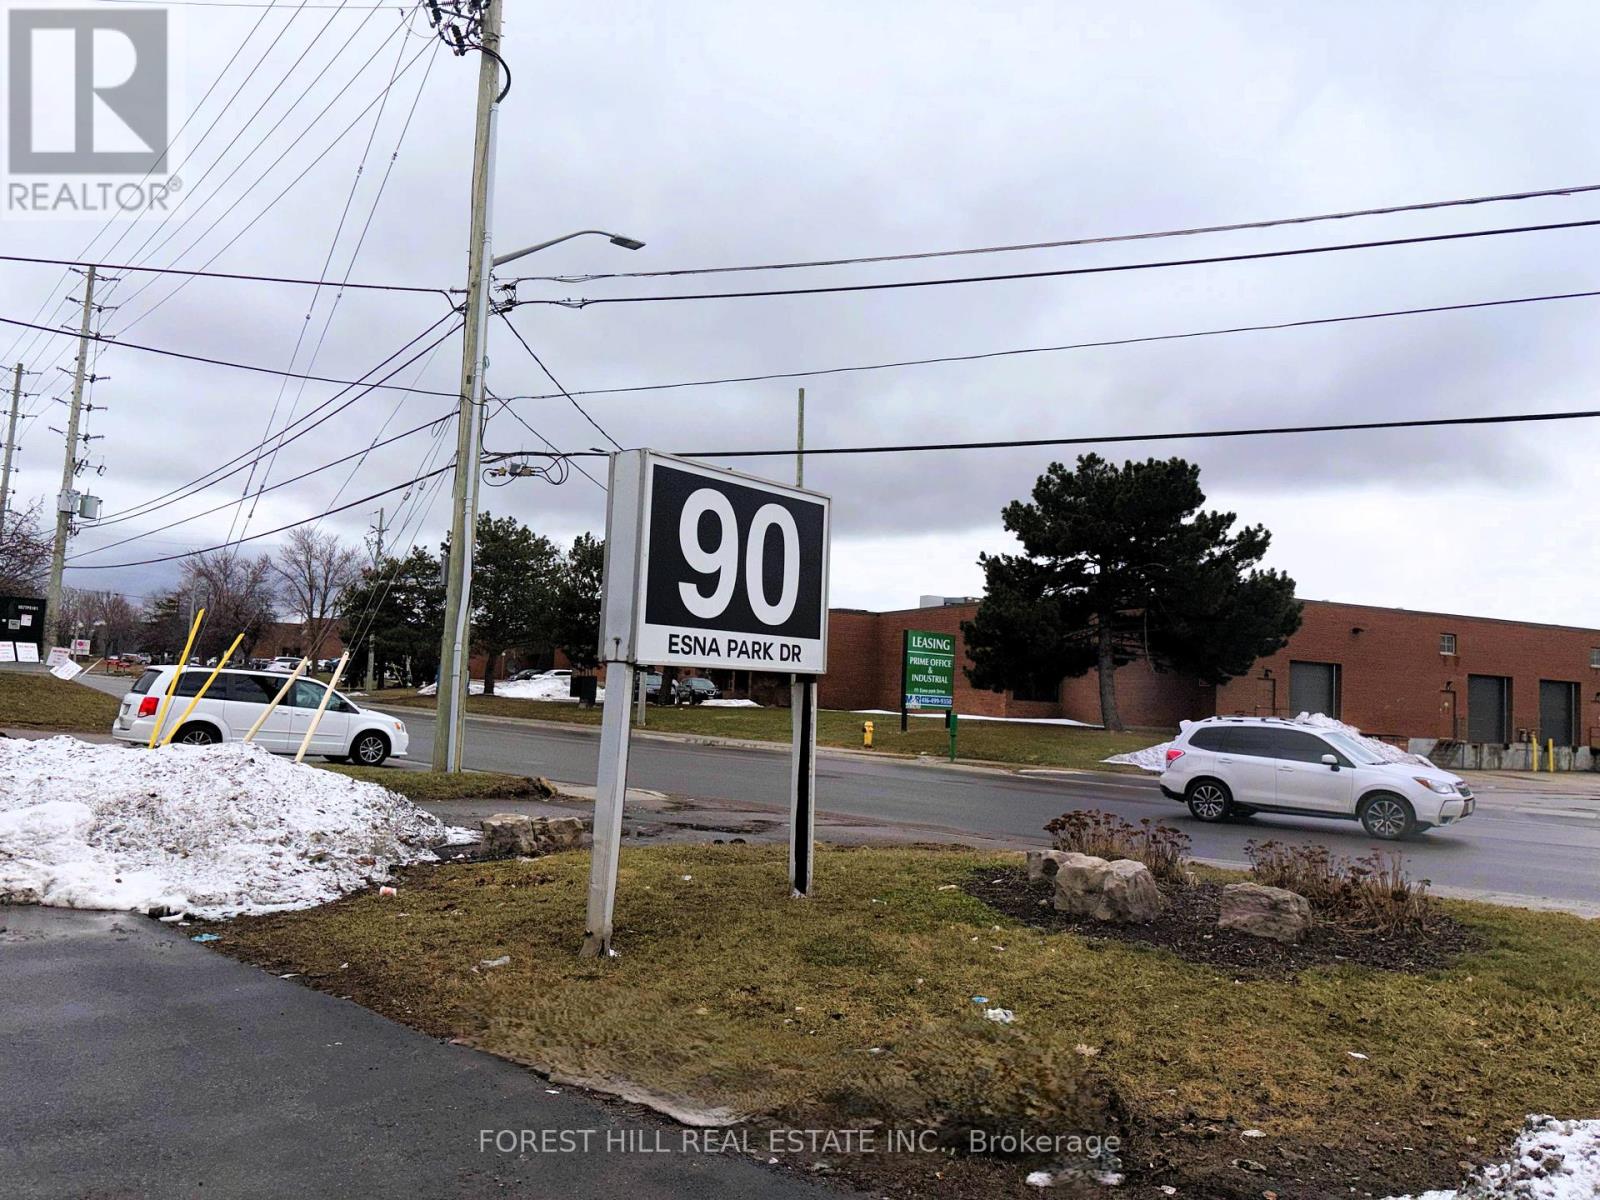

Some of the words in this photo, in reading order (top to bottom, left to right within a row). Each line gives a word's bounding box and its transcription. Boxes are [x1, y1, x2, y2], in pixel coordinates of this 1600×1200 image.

[678, 487, 801, 626] 90
[668, 633, 721, 657] ESNA
[726, 639, 774, 661] PARK
[779, 644, 802, 662] DR
[912, 636, 950, 650] LEASING
[909, 657, 929, 665] PRIME
[930, 658, 952, 667] OFFICE
[911, 674, 948, 683] INDUSTRIAL
